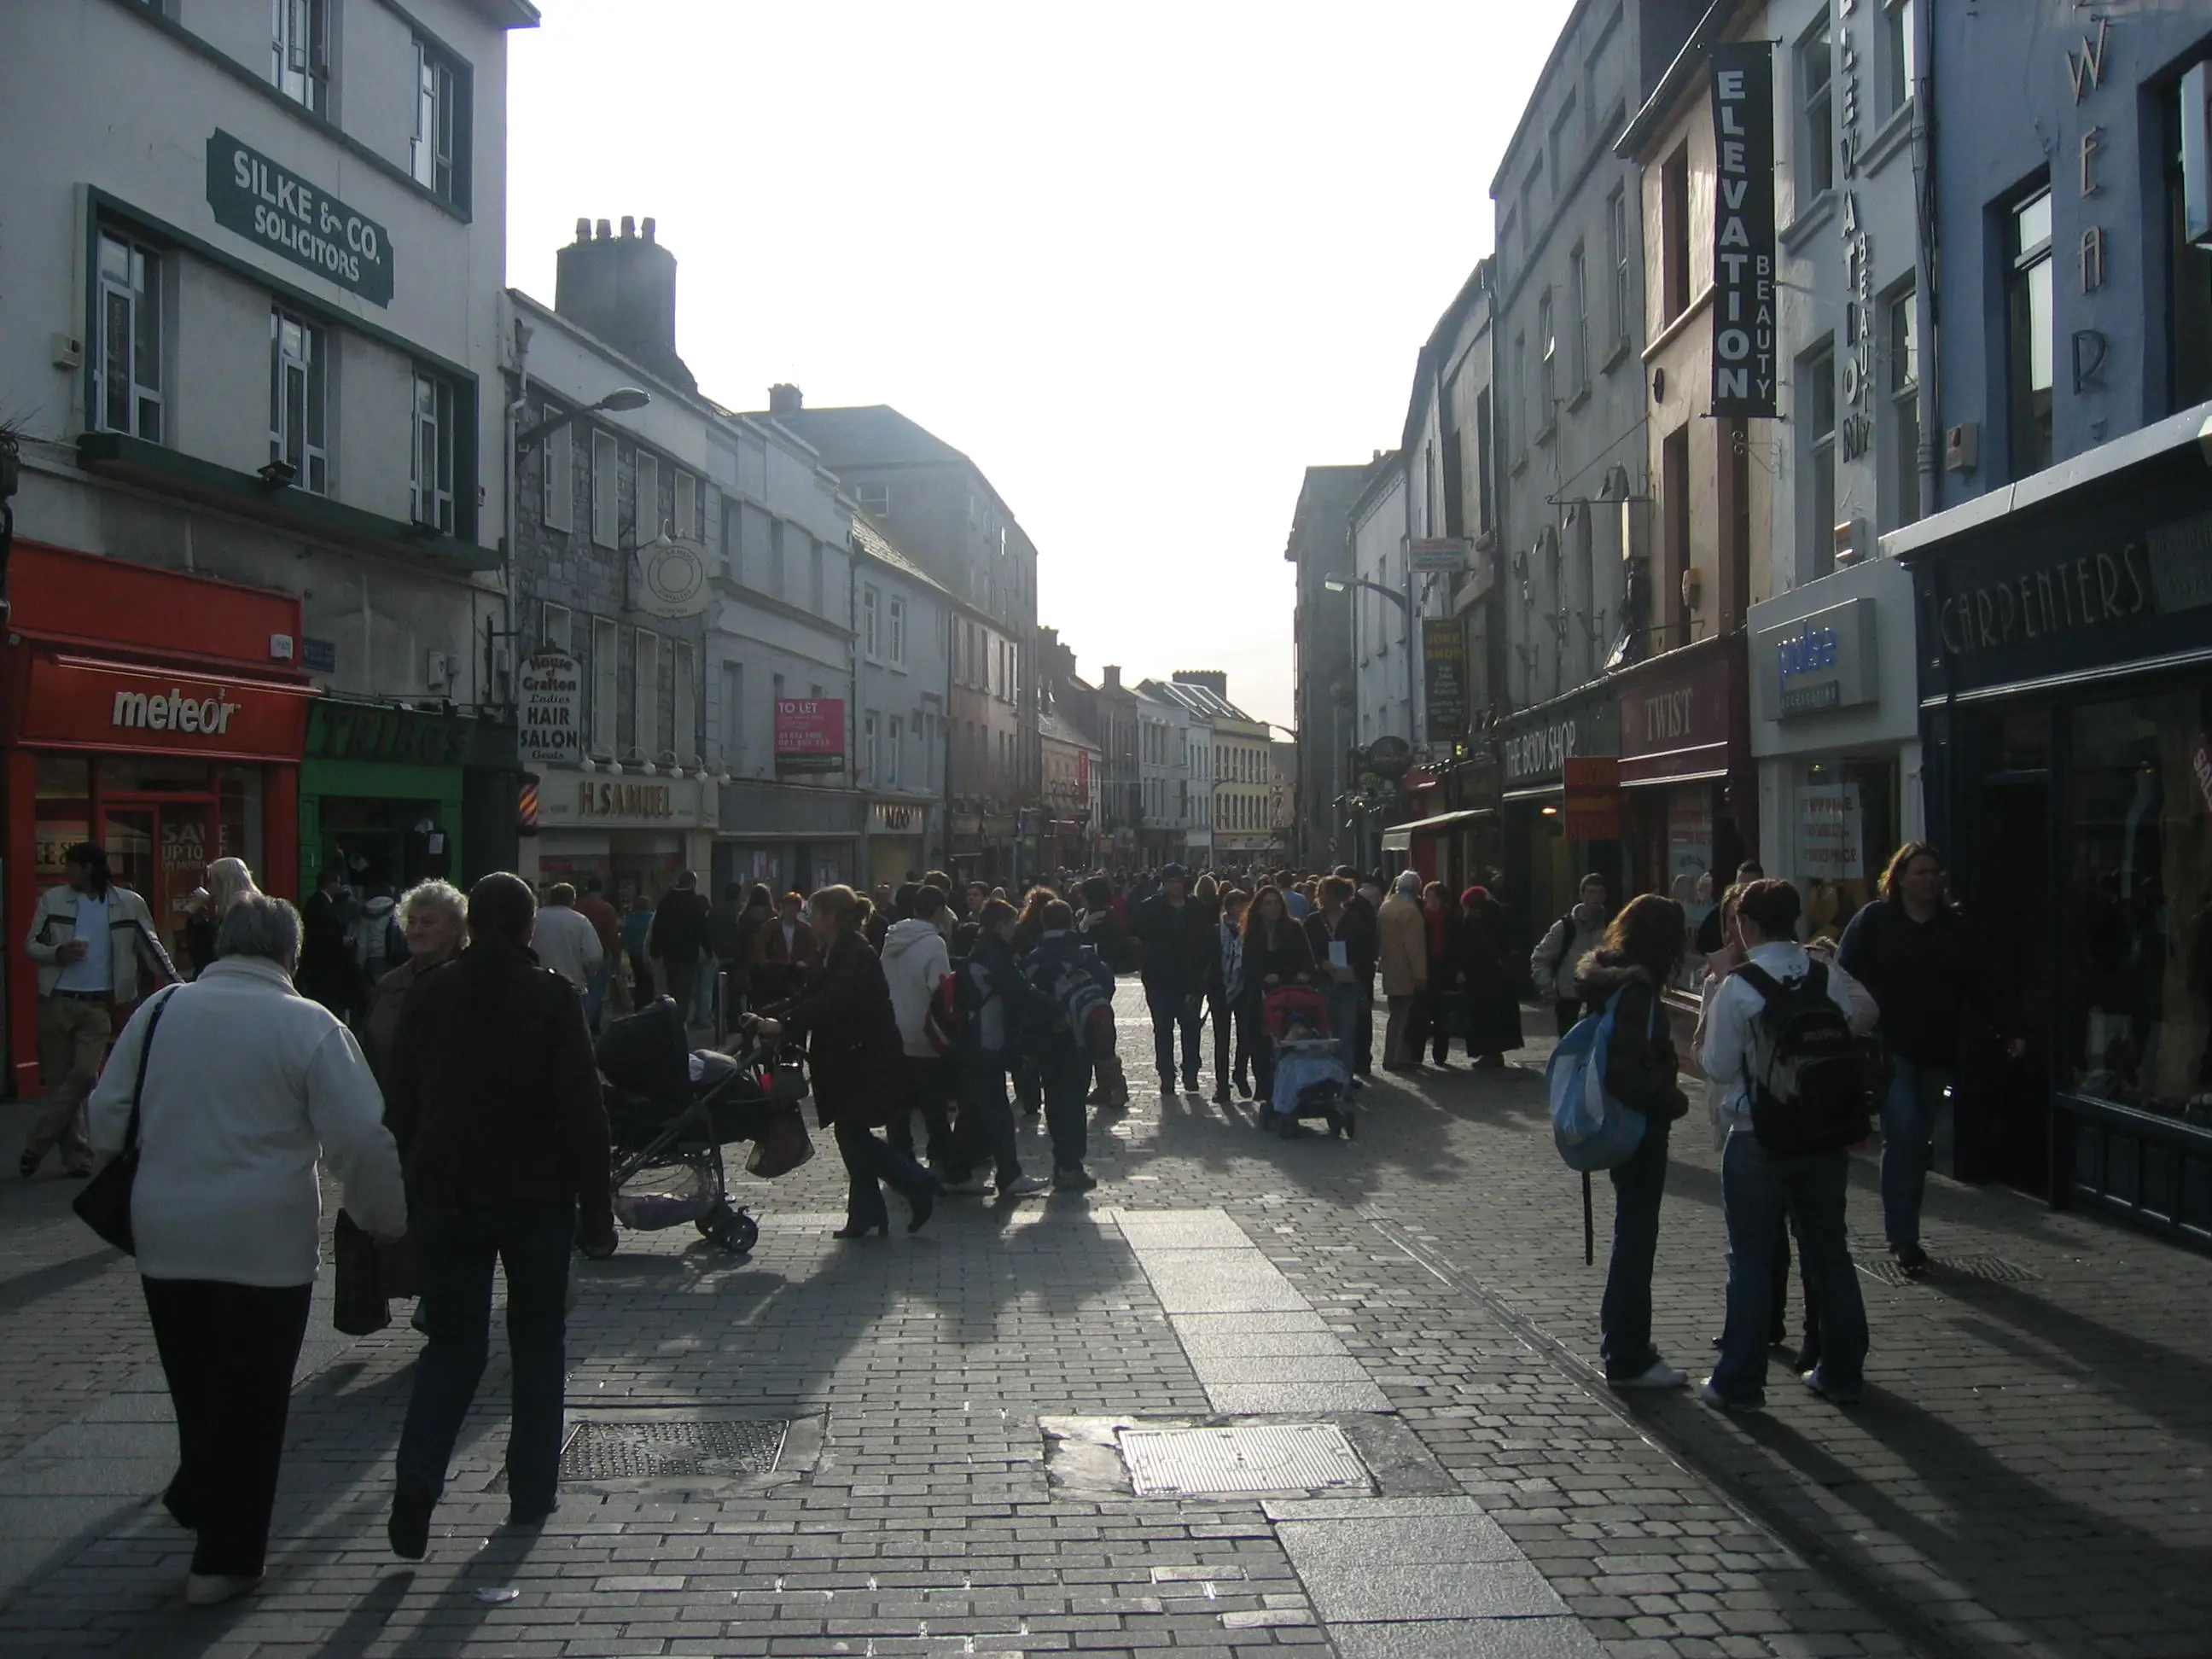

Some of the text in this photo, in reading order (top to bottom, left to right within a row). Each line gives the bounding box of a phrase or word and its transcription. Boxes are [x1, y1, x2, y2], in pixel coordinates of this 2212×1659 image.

[233, 149, 381, 265] SILKE & CO.
[253, 205, 360, 282] SOLICITORS
[1716, 69, 1750, 400] ELEVATION
[1755, 255, 1772, 400] BEAUTY
[1858, 231, 1870, 454] BEAUTY
[1941, 542, 2143, 655] CARPENTERS
[522, 677, 577, 691] Grafton
[529, 656, 573, 672] House
[113, 689, 235, 734] meteor
[527, 707, 570, 725] HAIR
[529, 694, 570, 703] Ladies
[778, 702, 818, 713] TO LET
[1644, 688, 1693, 742] TWIST
[520, 730, 577, 748] SALON
[1505, 736, 1522, 778] THE
[1522, 728, 1547, 774] BODY
[1548, 719, 1576, 771] SHOP
[162, 845, 182, 859] UP
[188, 845, 203, 859] TO
